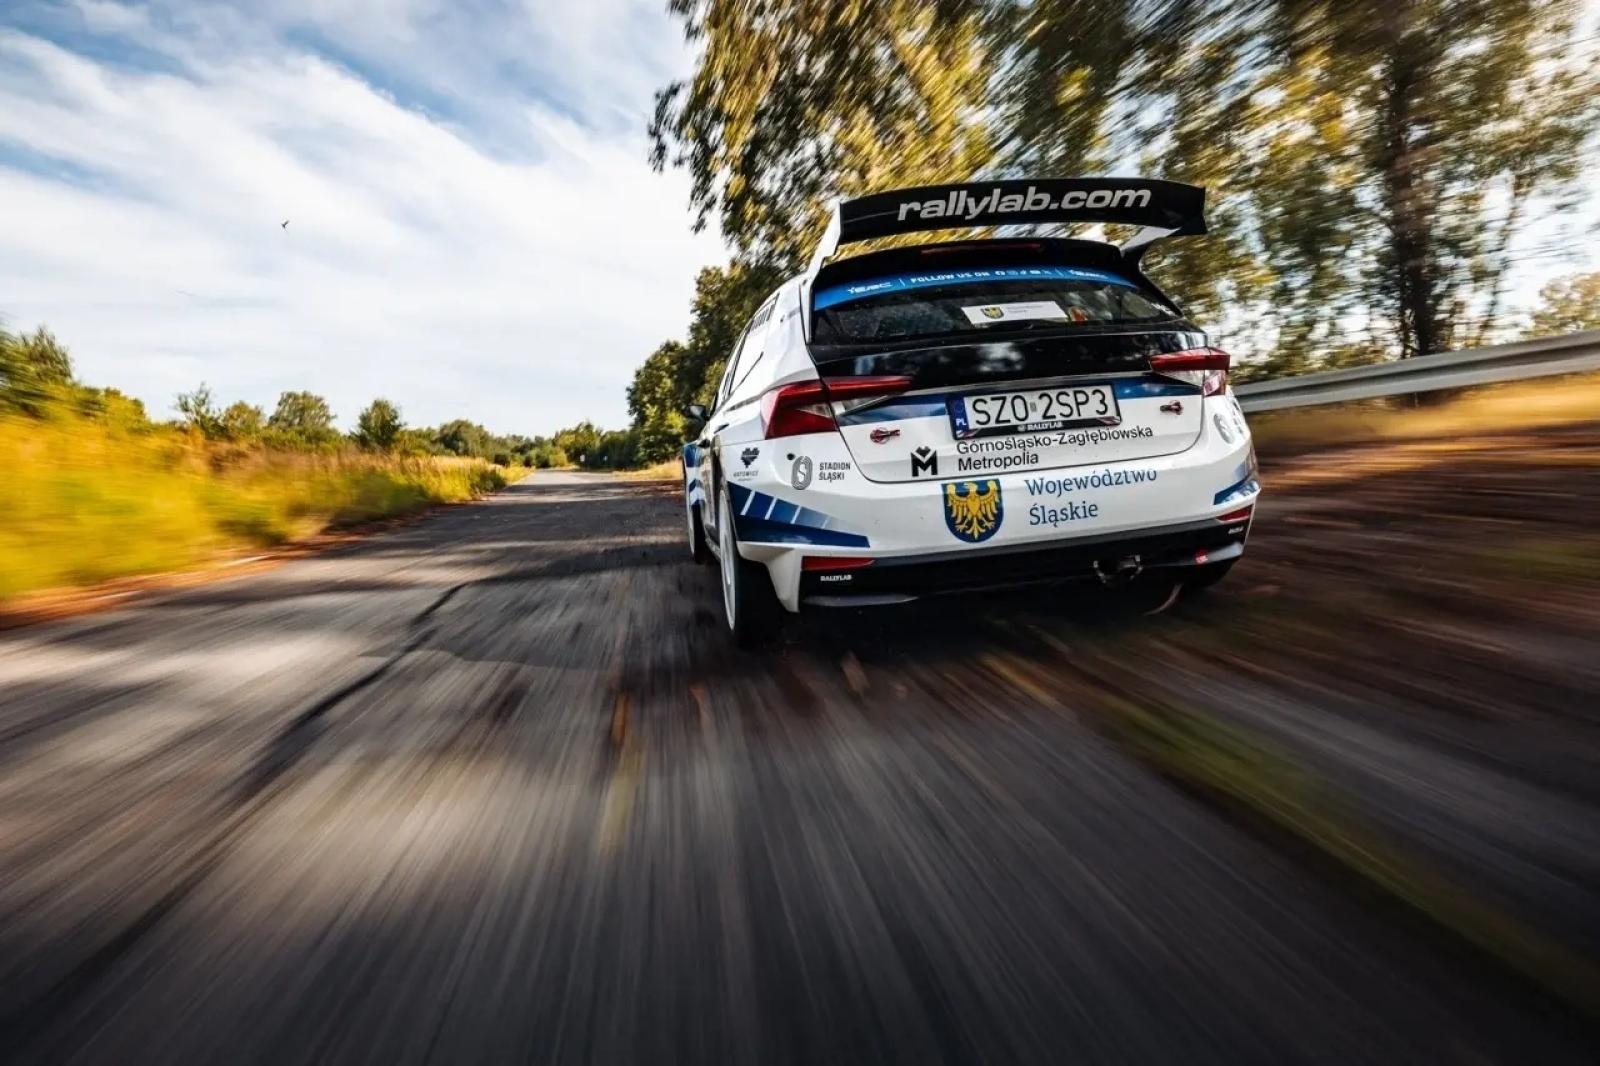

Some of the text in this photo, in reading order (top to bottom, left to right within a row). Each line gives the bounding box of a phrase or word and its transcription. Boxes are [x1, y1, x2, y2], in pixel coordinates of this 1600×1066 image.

[898, 186, 1152, 221] rallylab.com
[1038, 389, 1109, 420] 2SP3
[955, 418, 967, 427] PL
[956, 426, 1153, 455] Górnośląsko-Zagłębiowska
[819, 462, 851, 471] STADION
[958, 452, 1039, 472] Metropolia
[1024, 469, 1157, 497] Województwo
[1029, 500, 1099, 527] Śląskie
